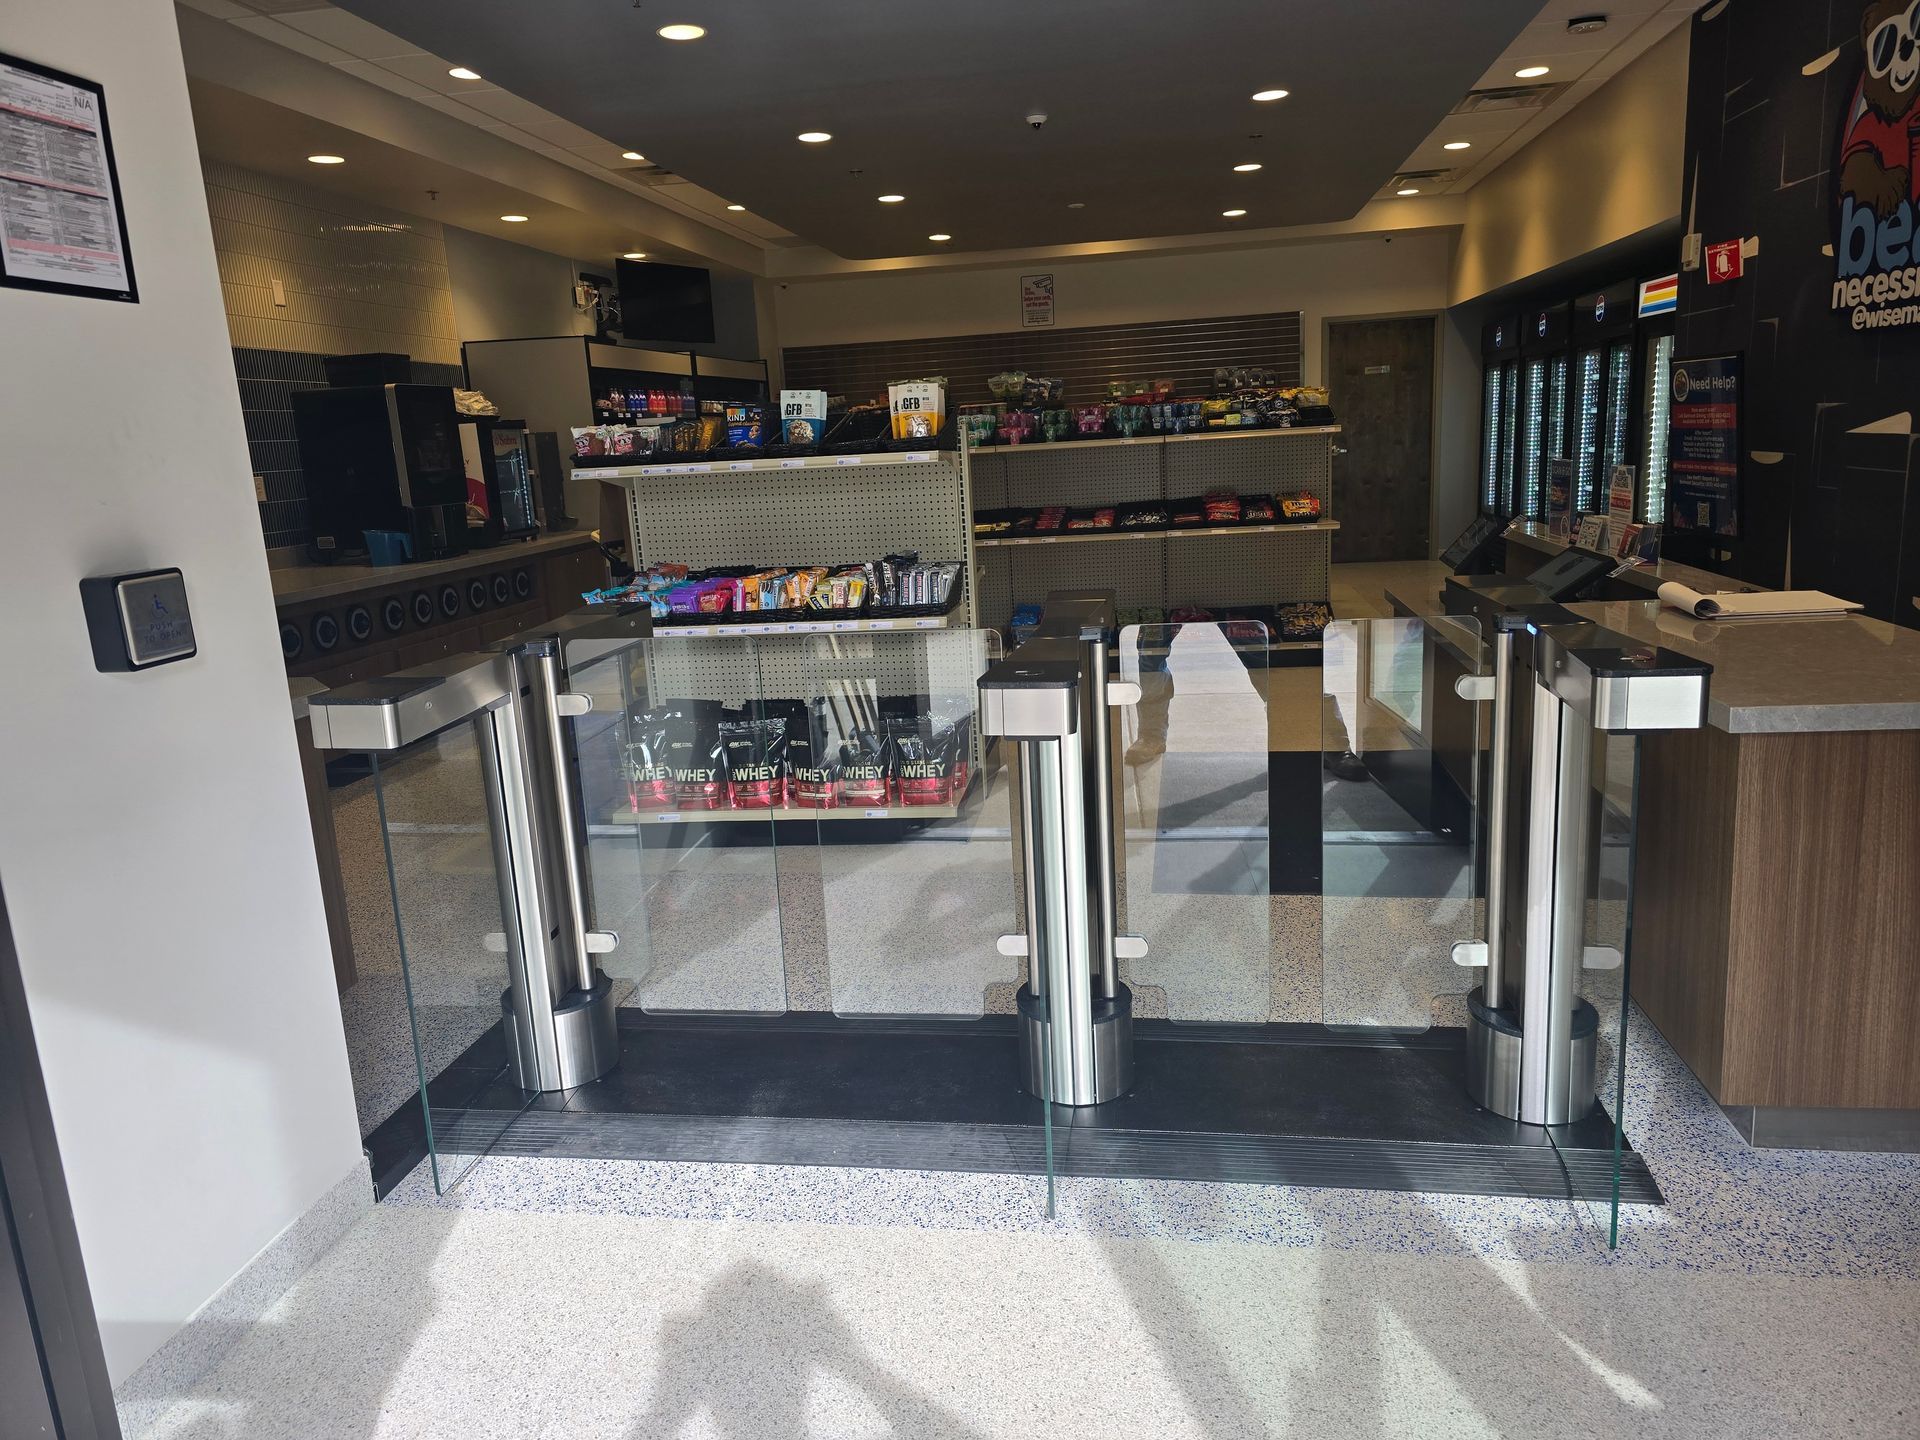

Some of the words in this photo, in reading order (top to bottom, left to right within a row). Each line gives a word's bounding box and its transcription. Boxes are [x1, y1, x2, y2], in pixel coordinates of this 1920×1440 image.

[1838, 196, 1920, 276] be
[1690, 376, 1710, 391] Need
[1712, 375, 1736, 391] Help?
[786, 403, 802, 415] GFB
[903, 397, 920, 410] GFB
[727, 414, 746, 422] KIND
[150, 622, 173, 631] PUSH
[144, 634, 156, 643] TO
[161, 630, 182, 641] OPEN
[634, 766, 673, 781] WHEY
[675, 768, 716, 782] WHEY
[735, 765, 778, 781] WHEY
[795, 767, 830, 782] WHEY
[843, 765, 884, 779] WHEY
[903, 764, 945, 778] WHEY
